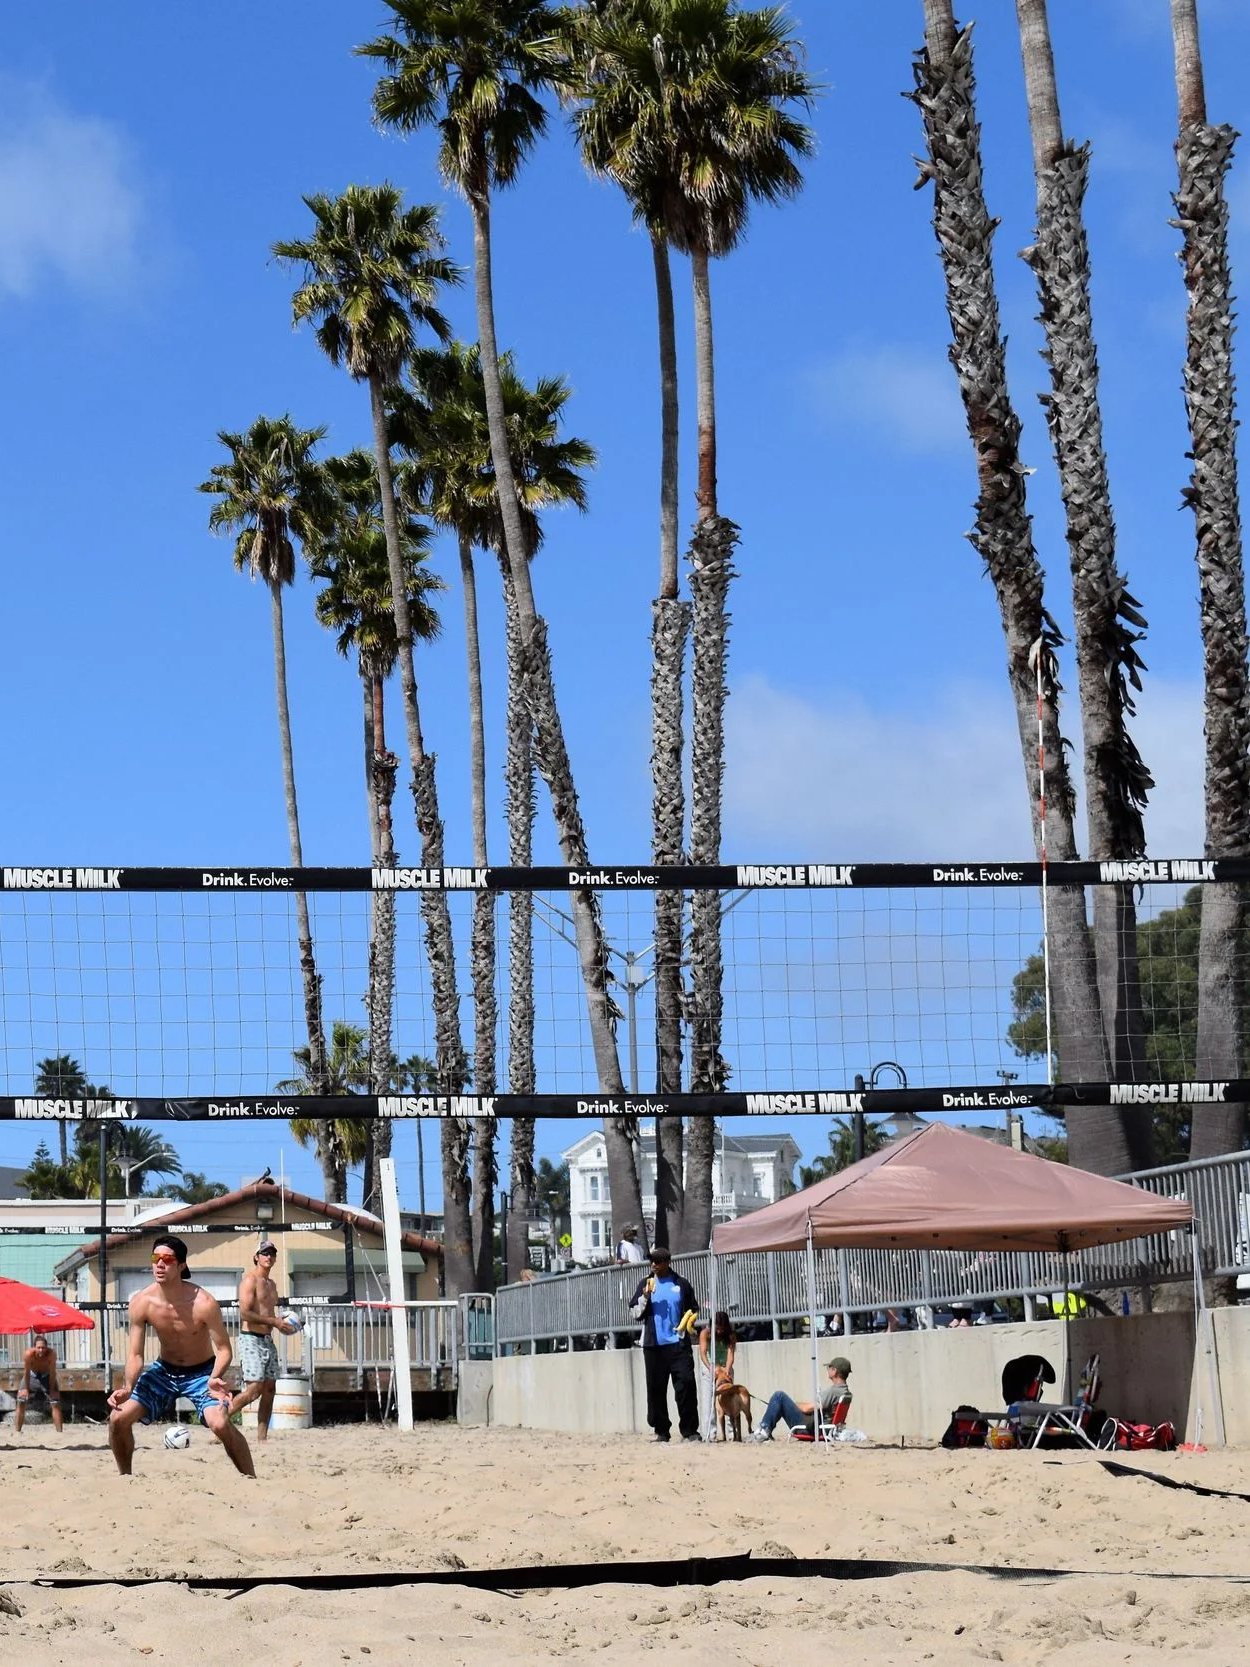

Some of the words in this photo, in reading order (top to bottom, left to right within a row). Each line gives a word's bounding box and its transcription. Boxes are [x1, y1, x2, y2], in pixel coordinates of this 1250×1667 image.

[4, 868, 72, 888] MUSCLE
[76, 868, 120, 888] MILK
[203, 872, 247, 885] Drink.
[372, 868, 440, 888] MUSCLE
[444, 868, 487, 887] MILK
[569, 871, 613, 884] Drink.
[737, 865, 805, 885] MUSCLE
[809, 865, 852, 884] MILK
[934, 868, 977, 881] Drink.
[1100, 861, 1168, 881] MUSCLE
[1172, 860, 1215, 880] MILK
[943, 1092, 987, 1106] Drink.
[1110, 1083, 1178, 1103] MUSCLE
[1182, 1082, 1225, 1101] MILK
[15, 1098, 81, 1118] MUSCLE
[87, 1099, 128, 1118] MILK
[209, 1102, 253, 1115] Drink.
[378, 1096, 447, 1116] MUSCLE
[451, 1096, 495, 1116] MILK
[578, 1099, 622, 1113] Drink.
[746, 1094, 815, 1113] MUSCLE
[818, 1093, 862, 1112] MILK
